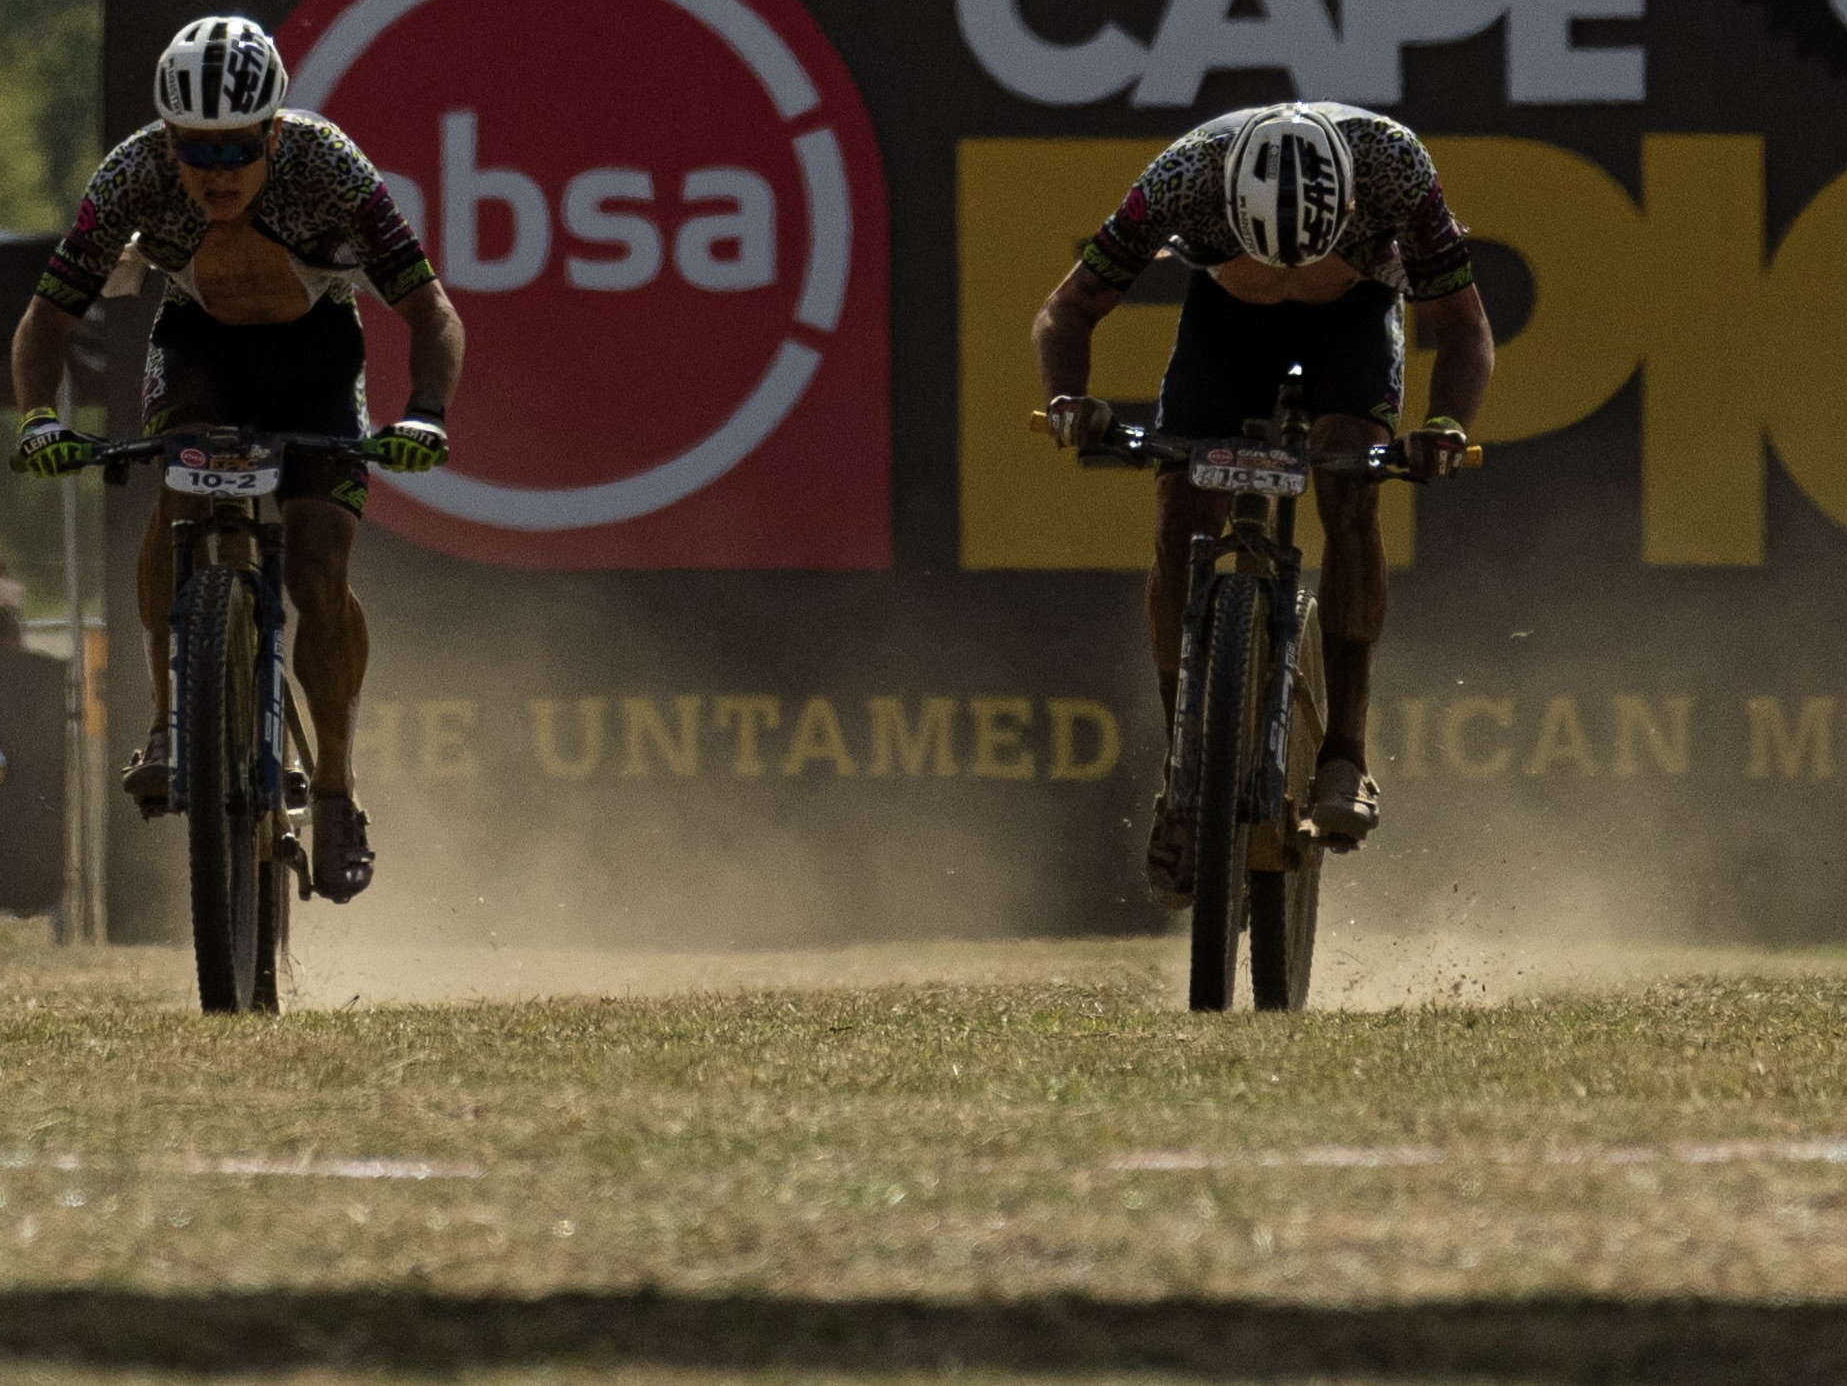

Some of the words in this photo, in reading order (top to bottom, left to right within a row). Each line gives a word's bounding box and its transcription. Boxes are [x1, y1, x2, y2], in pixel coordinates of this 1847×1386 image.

[188, 471, 257, 491] 10-2
[531, 691, 1122, 782] UNTAMED
[1366, 692, 1692, 782] ICAN
